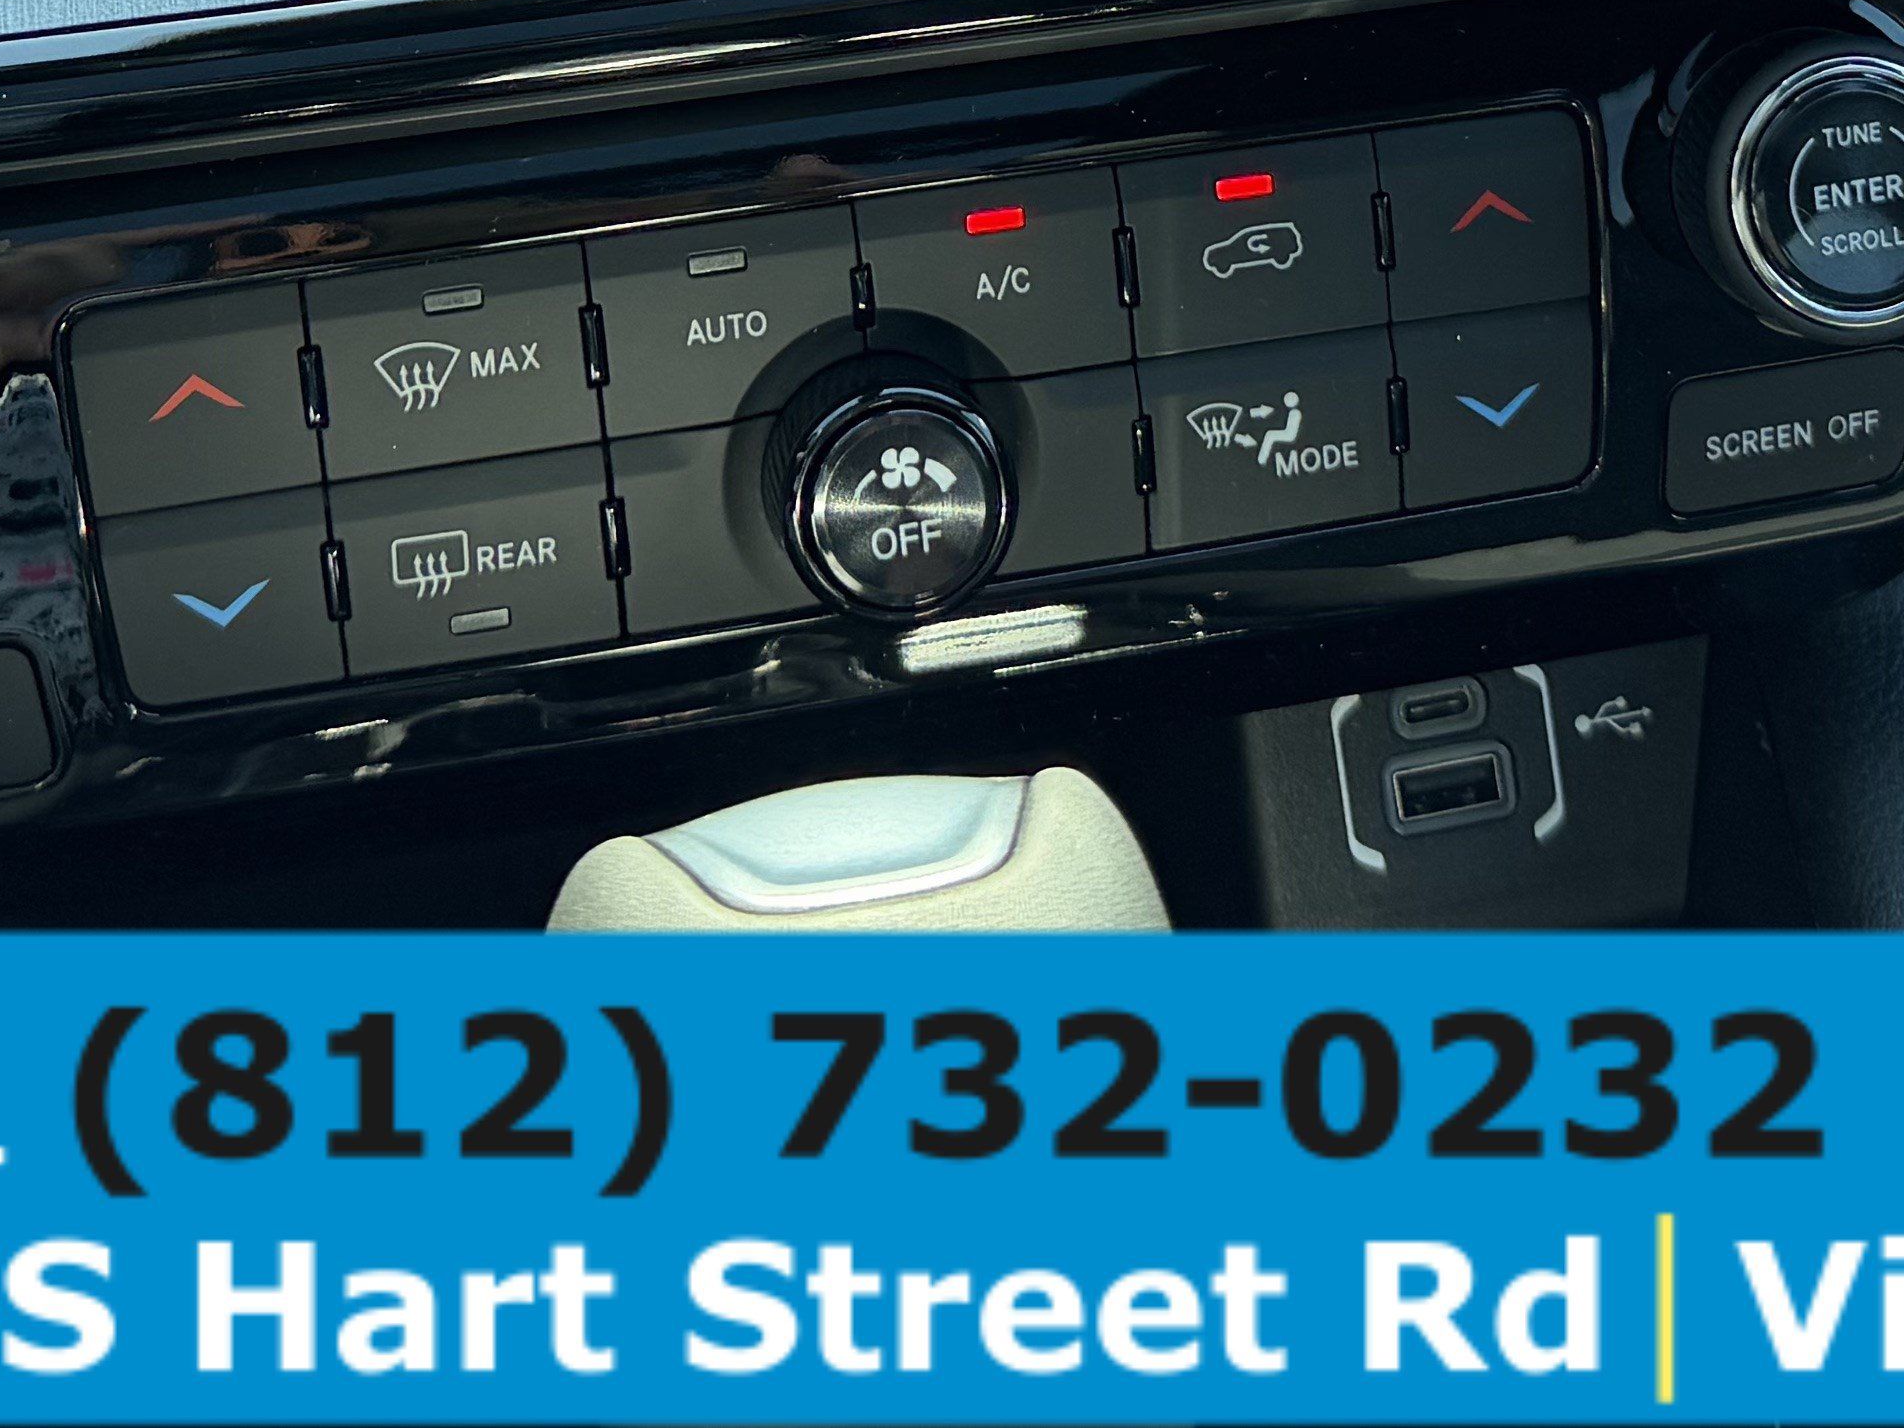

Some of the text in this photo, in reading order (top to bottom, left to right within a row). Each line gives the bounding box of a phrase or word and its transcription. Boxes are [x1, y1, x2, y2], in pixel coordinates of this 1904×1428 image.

[1822, 122, 1882, 147] TUNE
[1814, 174, 1904, 211] ENTER
[976, 267, 1031, 299] A/C
[687, 312, 768, 344] AUTO
[470, 342, 540, 379] MAX
[1706, 410, 1880, 460] SCREEN OFF
[1275, 441, 1358, 477] MODE
[476, 539, 557, 576] REAR
[872, 521, 942, 560] OFF
